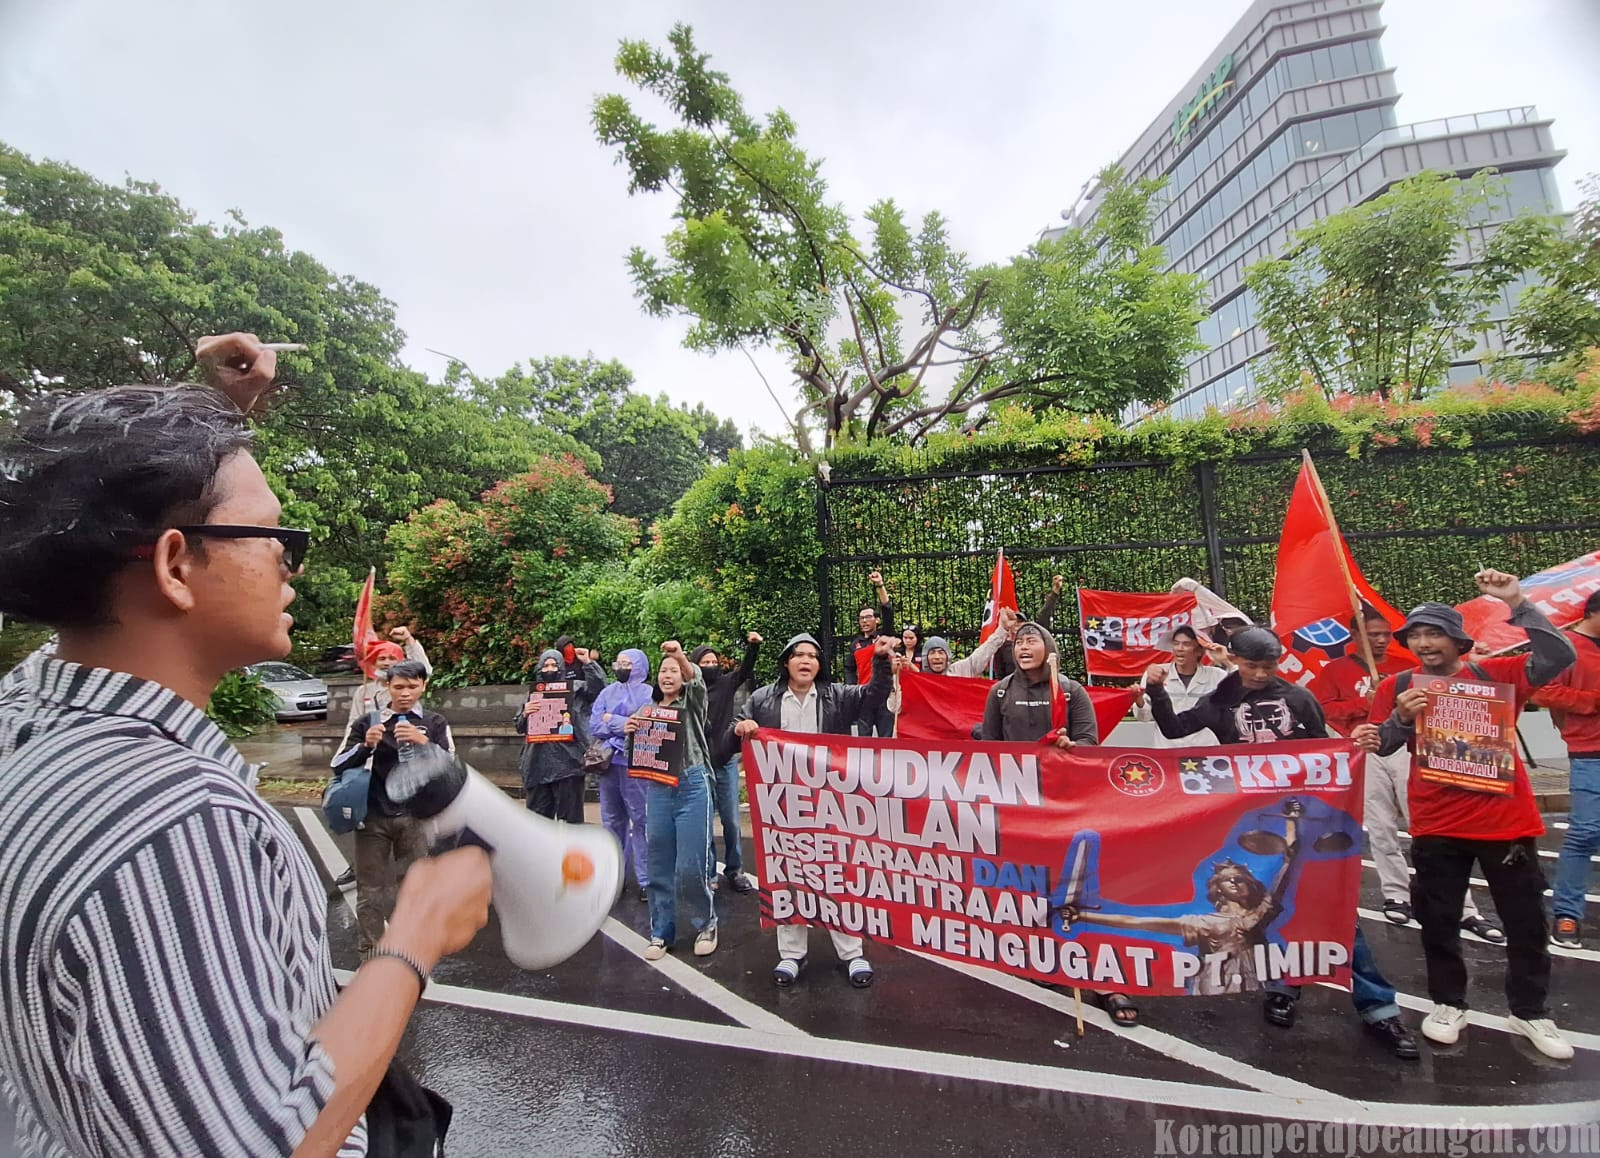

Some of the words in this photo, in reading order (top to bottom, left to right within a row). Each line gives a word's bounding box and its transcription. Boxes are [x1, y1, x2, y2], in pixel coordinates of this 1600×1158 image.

[1437, 695, 1488, 713] BERIKAN
[1464, 683, 1496, 697] KPBI
[1426, 716, 1454, 730] BAGI
[1458, 721, 1499, 738] BURUH
[1433, 706, 1491, 724] KEADILAN
[751, 739, 1041, 806] WUJUDKAN
[1234, 752, 1352, 788] KPBI
[1428, 756, 1498, 779] MORAWALI
[755, 783, 998, 856] KEADILAN
[762, 827, 963, 883] KESETARAAN
[972, 858, 1048, 892] DAN
[765, 856, 1048, 928] KESEJAHTRAAN
[771, 889, 890, 939] BURUH
[911, 913, 1154, 987] MENGUGAT
[1172, 951, 1243, 988] PT.
[1254, 941, 1348, 982] IMIP
